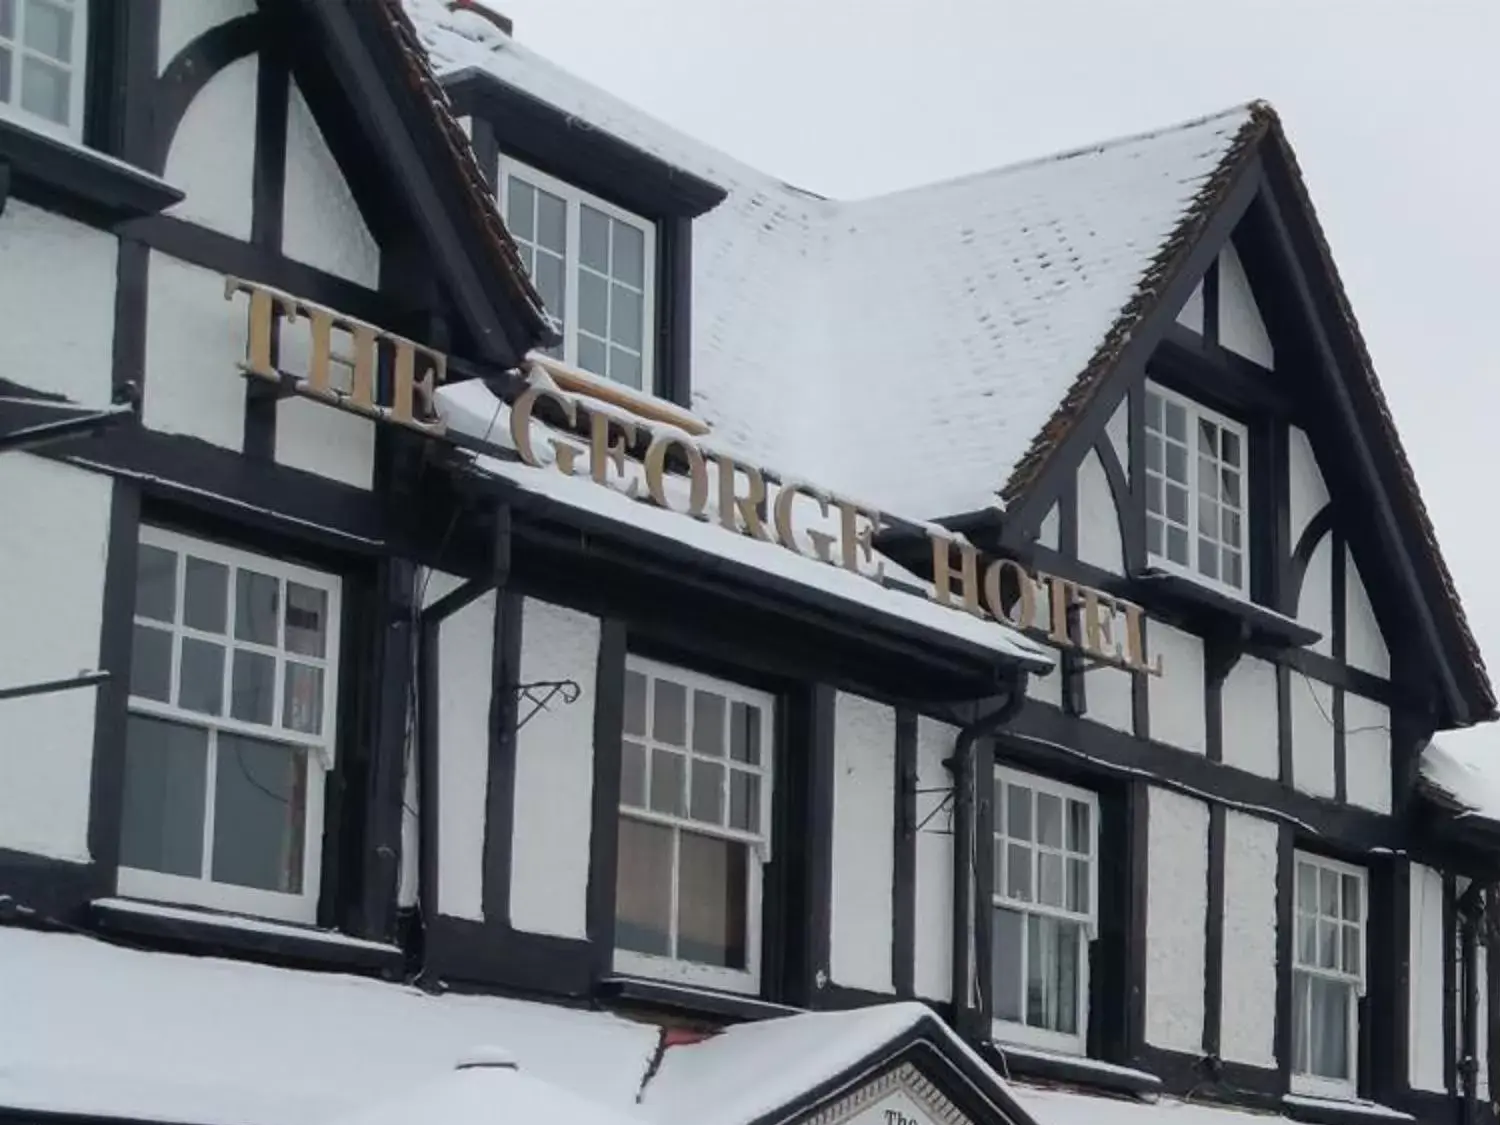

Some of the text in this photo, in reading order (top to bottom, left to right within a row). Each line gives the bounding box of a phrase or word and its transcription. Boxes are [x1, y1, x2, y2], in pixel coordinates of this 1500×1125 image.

[224, 276, 1163, 677] THE GEORGE HOTEL
